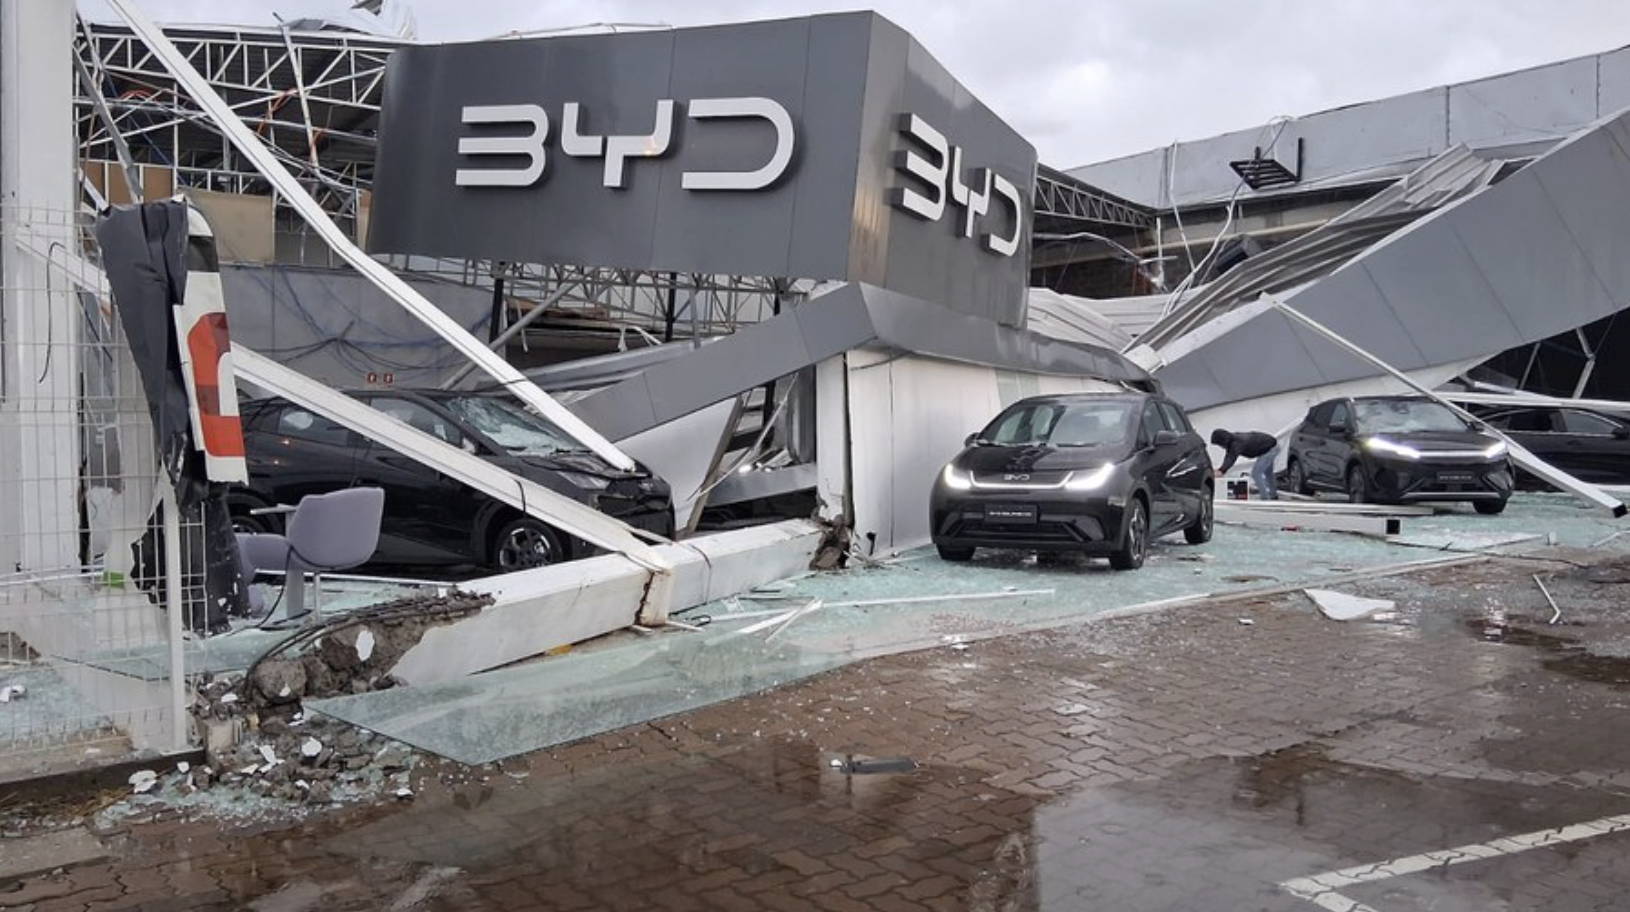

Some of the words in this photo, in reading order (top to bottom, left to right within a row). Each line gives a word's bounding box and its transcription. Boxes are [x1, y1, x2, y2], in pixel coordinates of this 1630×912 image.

[456, 97, 795, 190] BYD
[900, 112, 1022, 257] BYD
[1003, 473, 1030, 481] BYD
